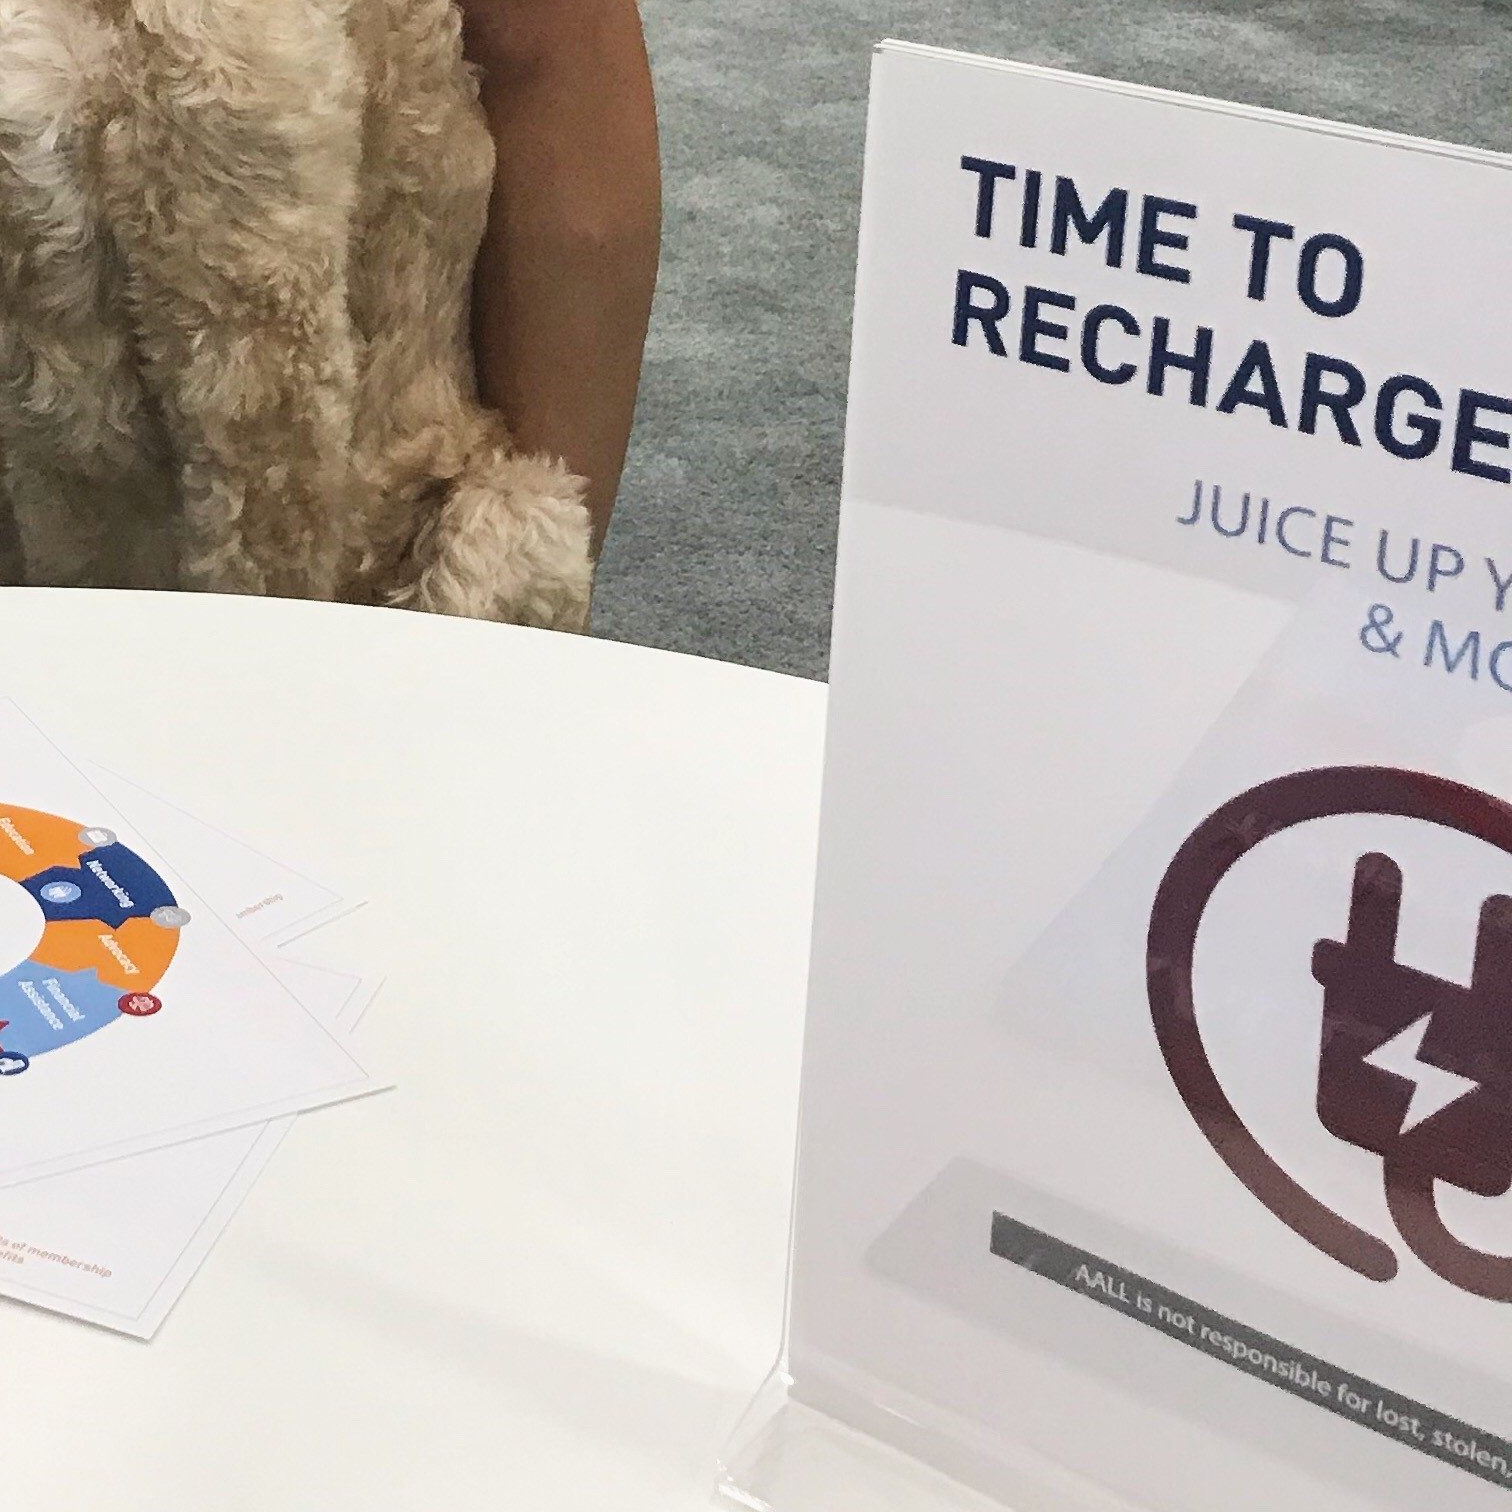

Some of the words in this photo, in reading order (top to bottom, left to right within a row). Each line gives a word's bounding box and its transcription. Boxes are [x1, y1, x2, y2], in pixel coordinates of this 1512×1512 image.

[960, 154, 1198, 285] TIME
[1232, 212, 1365, 318] TO
[951, 268, 1512, 485] RECHARGE
[1176, 479, 1354, 569] JUICE
[1376, 528, 1465, 592] UP
[1360, 602, 1403, 658] &
[86, 860, 135, 908] Networking
[98, 934, 140, 975] Advocacy
[1073, 1263, 1130, 1305] AALL
[1136, 1290, 1153, 1314] is
[1158, 1303, 1195, 1336] not
[1200, 1322, 1332, 1397] responsible
[1337, 1381, 1372, 1414] for
[1376, 1399, 1426, 1442] lost,
